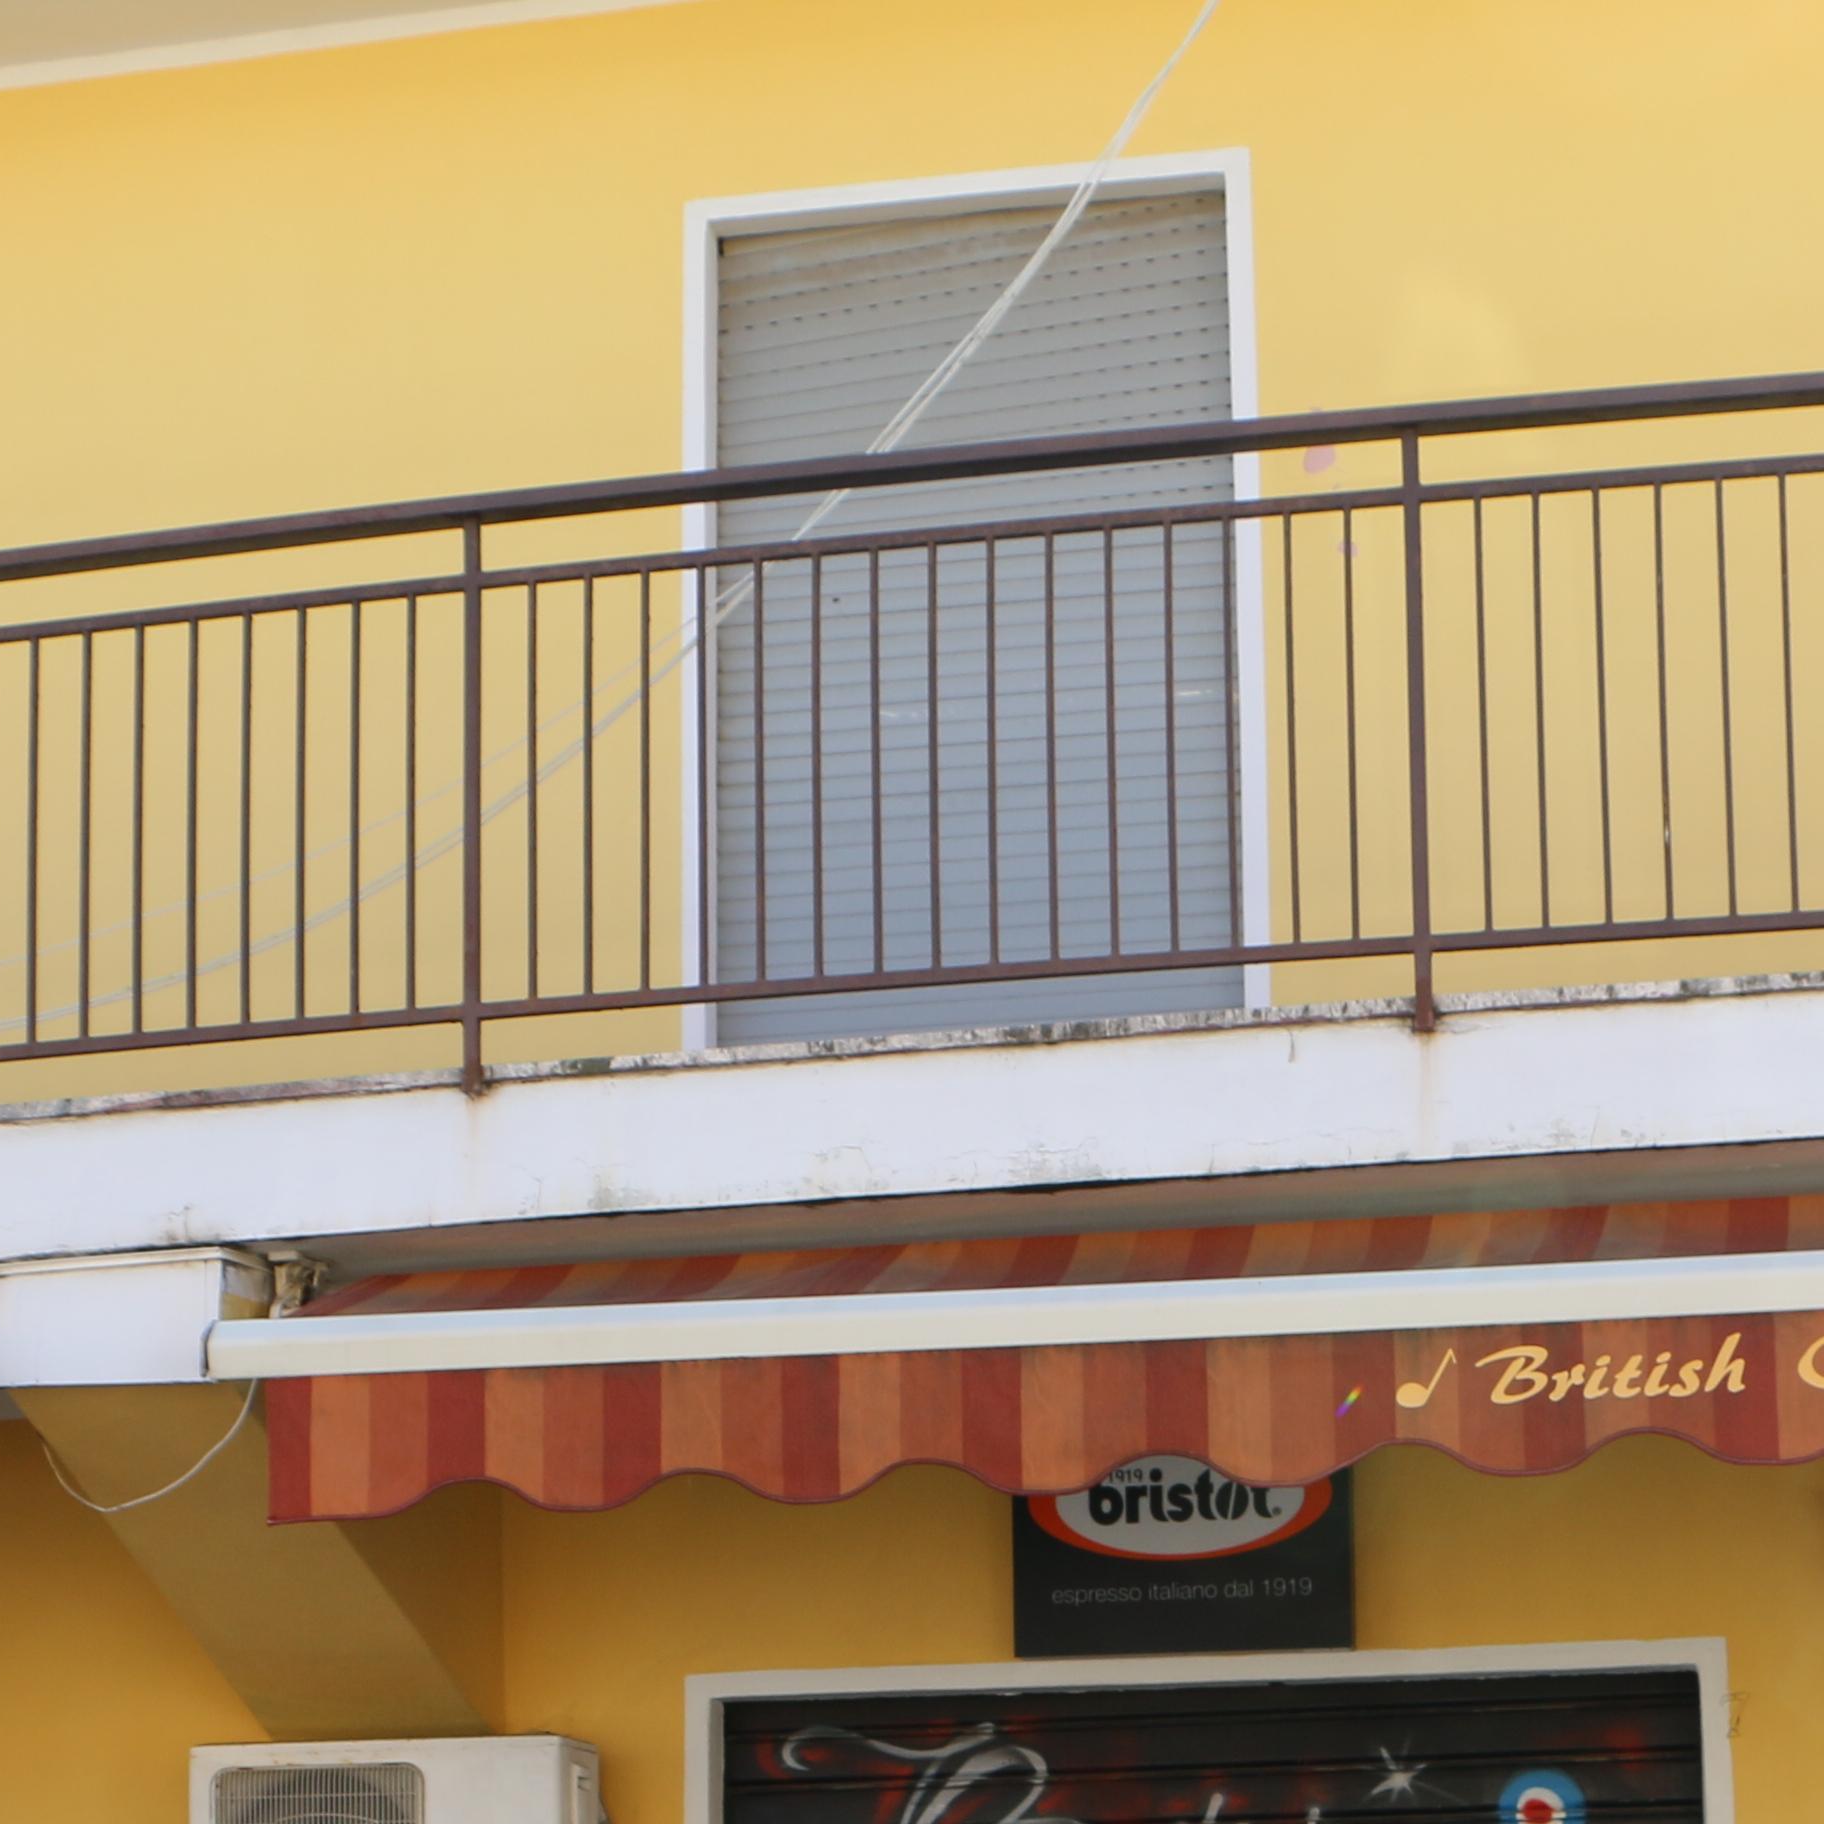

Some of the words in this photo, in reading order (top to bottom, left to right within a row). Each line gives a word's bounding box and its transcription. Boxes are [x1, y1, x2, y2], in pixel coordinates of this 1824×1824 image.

[1473, 1332, 1747, 1404] British
[1052, 1585, 1143, 1607] espresso
[1148, 1582, 1218, 1602] italiano
[1224, 1580, 1255, 1598] dal
[1263, 1577, 1313, 1597] 1919
